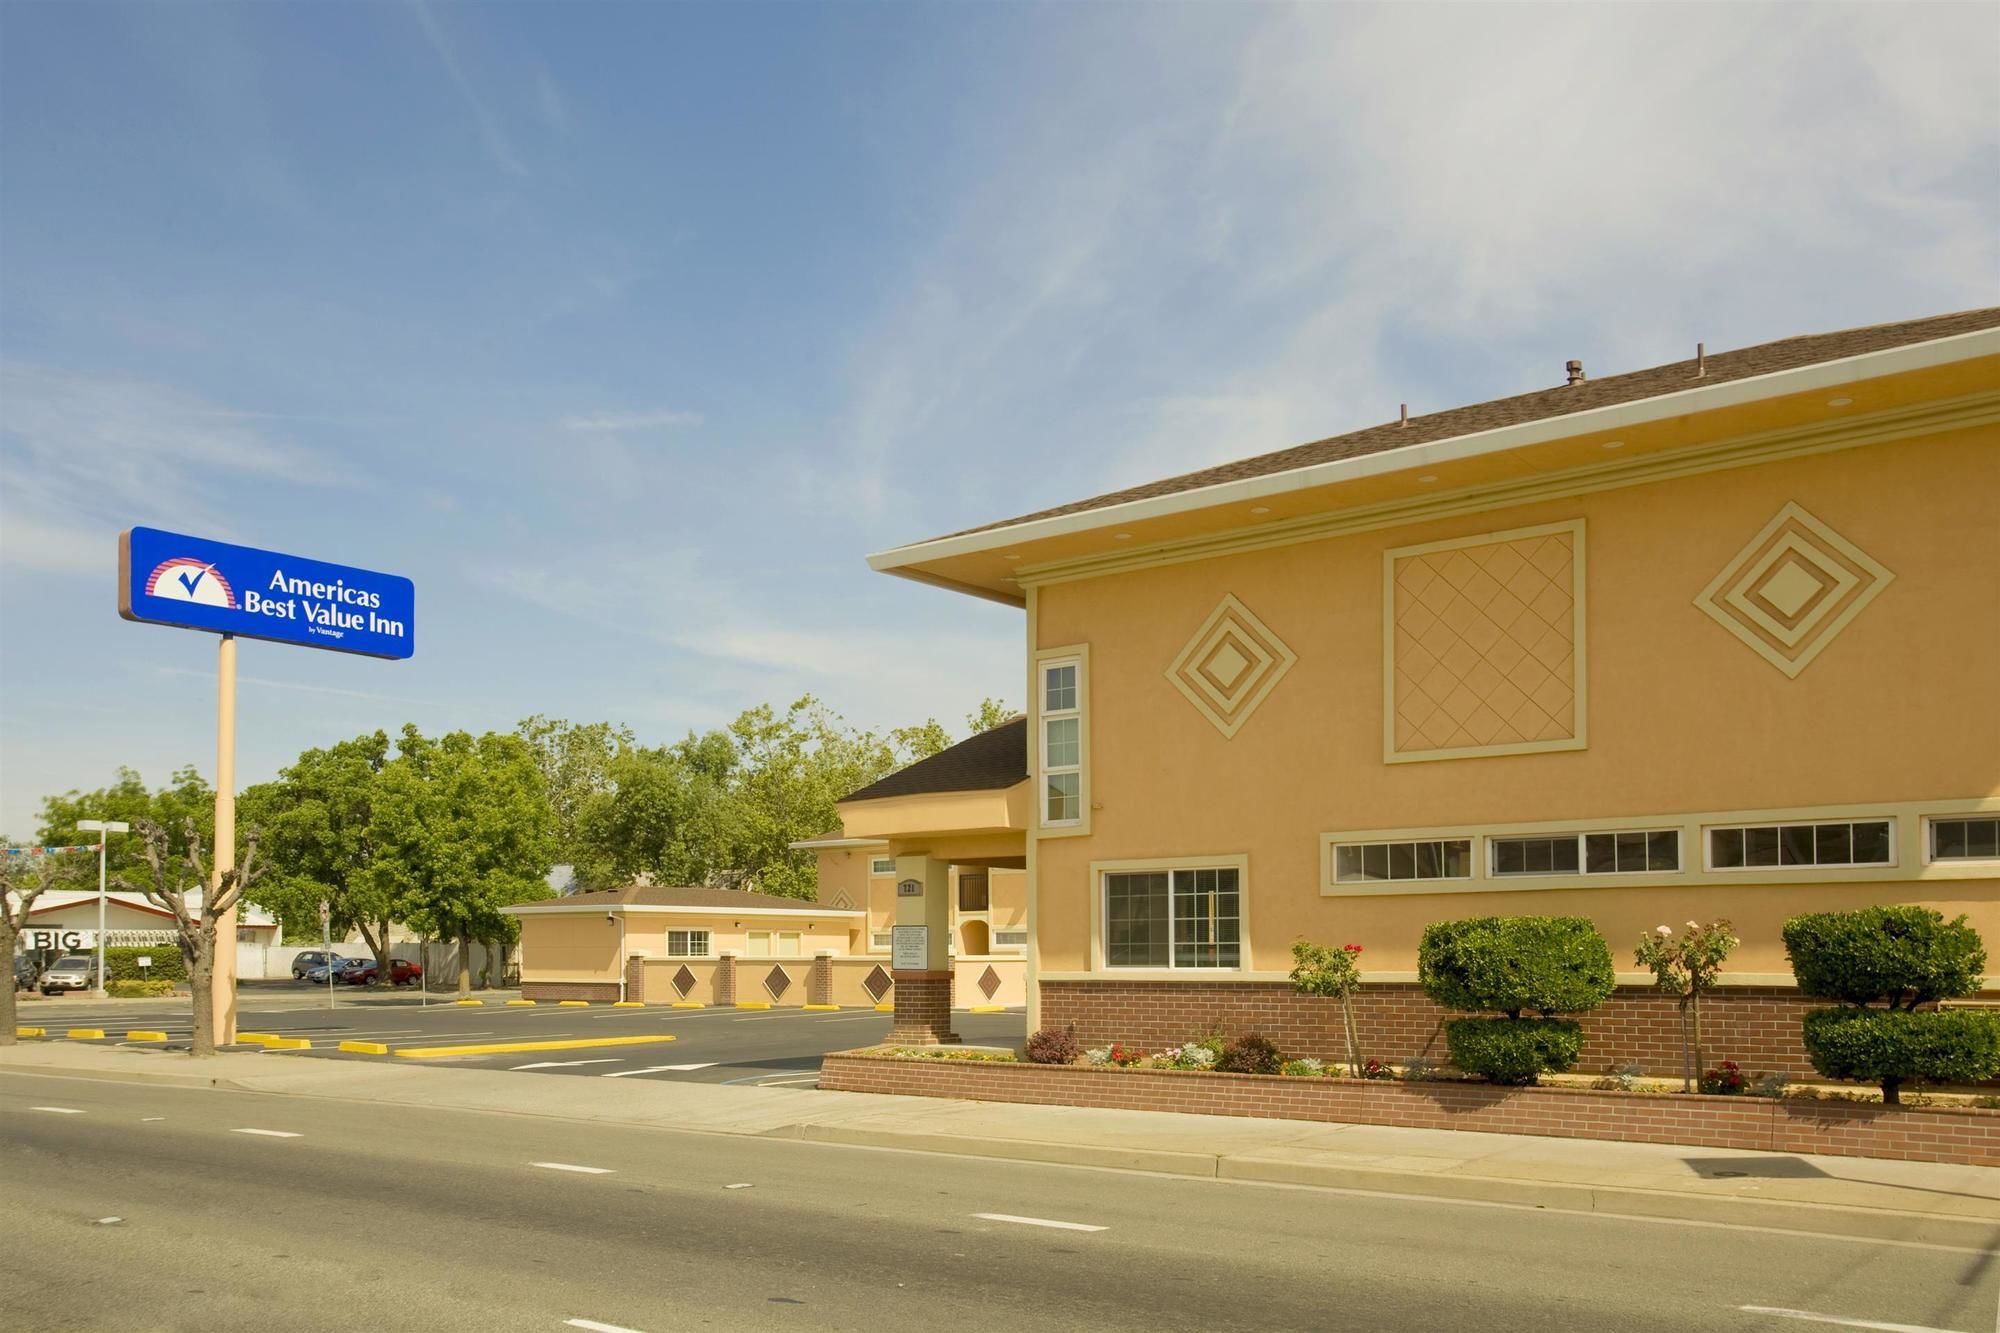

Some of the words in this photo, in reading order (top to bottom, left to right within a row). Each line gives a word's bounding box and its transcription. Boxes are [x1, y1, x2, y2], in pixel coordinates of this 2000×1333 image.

[269, 569, 380, 608] Americas
[245, 590, 296, 619] Best
[302, 600, 364, 630] Value
[370, 611, 404, 637] Inn
[308, 626, 316, 635] by
[316, 626, 344, 639] Vantage
[35, 932, 81, 950] BIG
